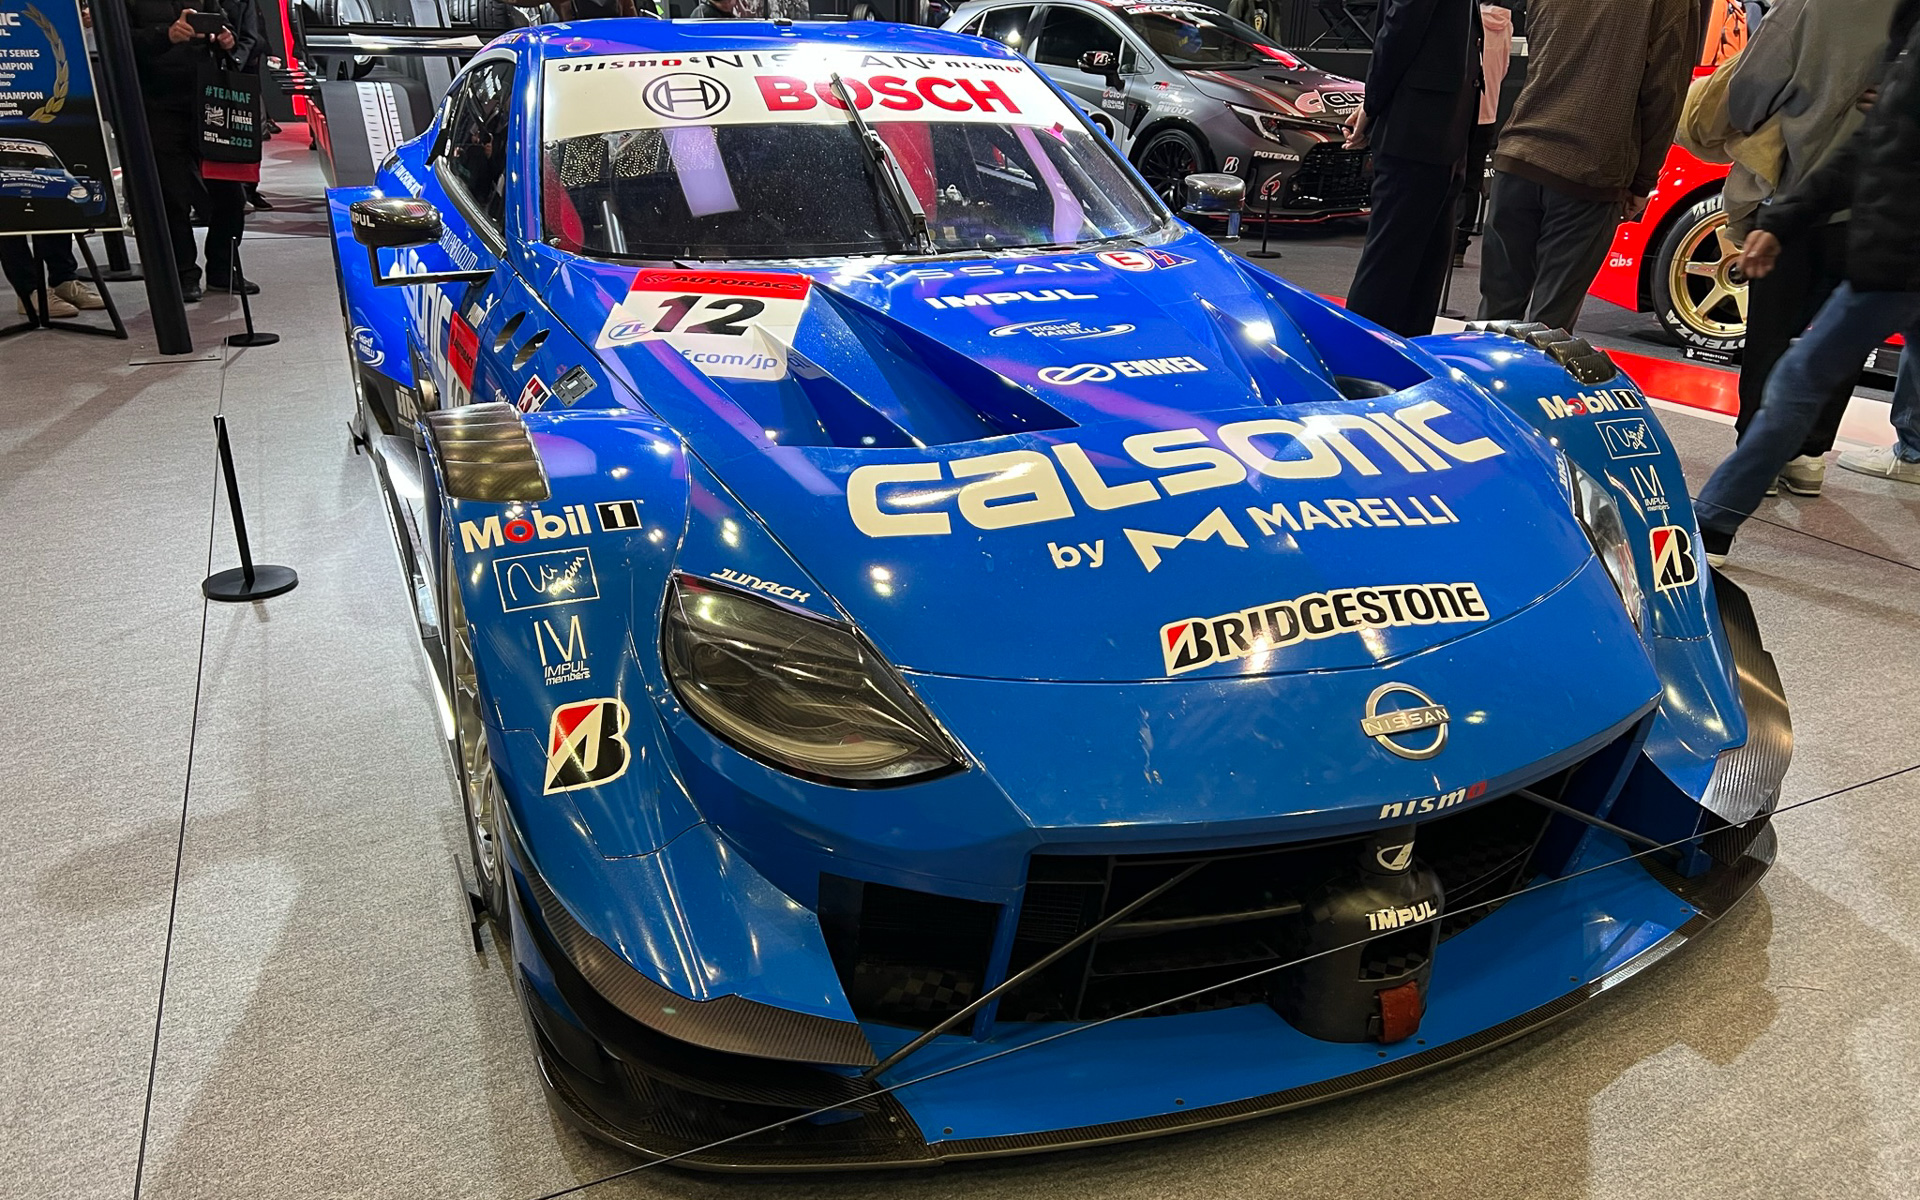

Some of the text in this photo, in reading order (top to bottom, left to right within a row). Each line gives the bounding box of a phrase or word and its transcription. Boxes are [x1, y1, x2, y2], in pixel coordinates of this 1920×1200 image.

[9, 49, 40, 58] SERIES
[573, 58, 682, 72] nismo
[205, 85, 251, 104] #TEAMAF
[754, 75, 1023, 114] BOSCH
[230, 136, 252, 148] 2023
[1253, 150, 1300, 162] POTENZA
[351, 211, 375, 228] PUL
[1609, 254, 1633, 268] abs
[672, 275, 803, 291] AUTOBACS
[849, 261, 1101, 286] NISSAN
[924, 289, 1098, 310] IMPUL
[652, 294, 766, 337] 12
[1032, 327, 1102, 339] MARELLI
[1665, 308, 1746, 350] TENZA
[1114, 355, 1209, 378] ENKEI
[1538, 389, 1618, 420] Mobil
[1643, 496, 1669, 506] IMPUL
[459, 504, 592, 553] Mobil
[1047, 538, 1106, 570] by
[1246, 494, 1460, 537] MARELLI
[710, 567, 811, 603] JUNACK
[1161, 581, 1489, 674] BRIDGESTONE
[544, 660, 590, 678] IMPUL
[545, 670, 591, 686] members
[1364, 707, 1450, 735] NISSAN
[1379, 780, 1488, 820] nismo
[1366, 900, 1437, 932] IMPUL
